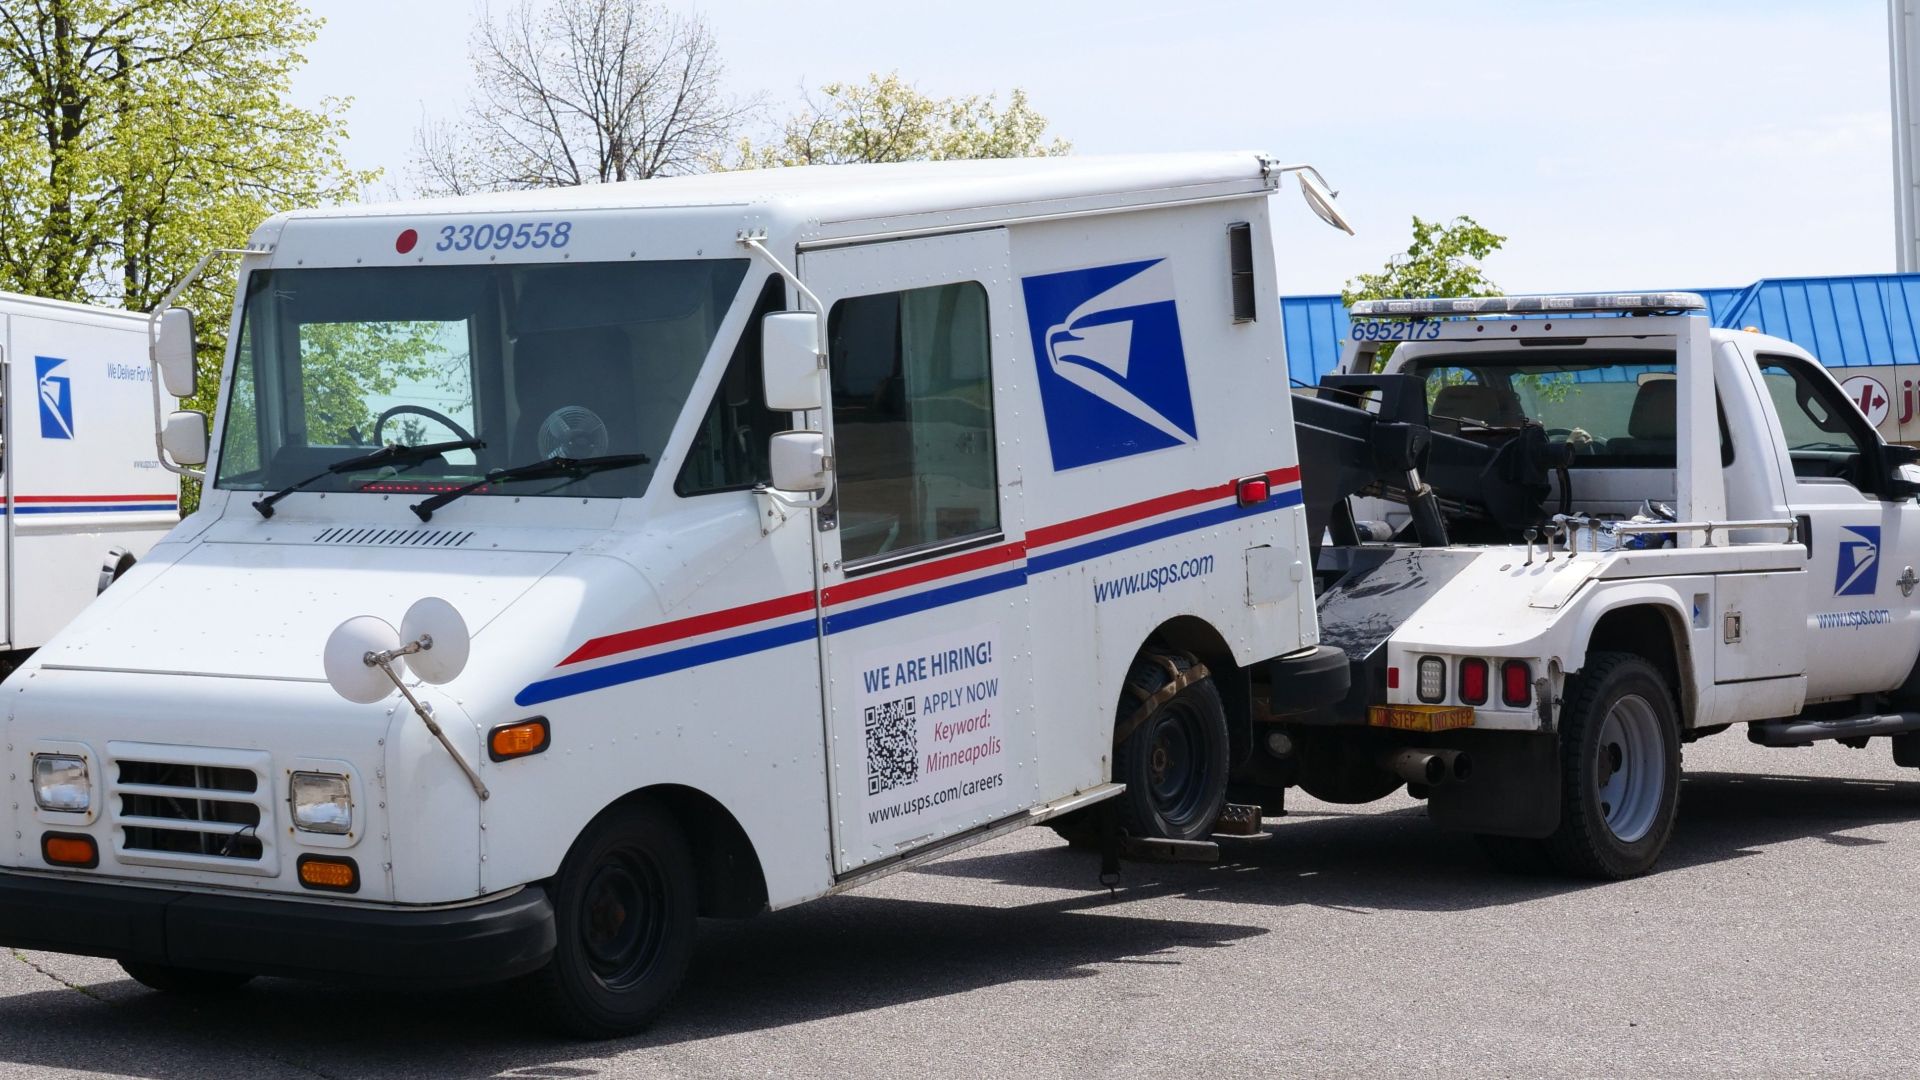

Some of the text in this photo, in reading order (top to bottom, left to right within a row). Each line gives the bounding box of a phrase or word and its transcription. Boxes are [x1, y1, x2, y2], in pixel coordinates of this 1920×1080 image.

[436, 221, 572, 252] 3309558
[1351, 320, 1441, 341] 6952173
[107, 362, 117, 379] We
[117, 363, 136, 381] Deliver
[136, 366, 146, 382] For
[1094, 554, 1214, 603] www.usps.com
[1816, 609, 1891, 631] www.usps.com
[863, 641, 993, 694] WE ARE HIRING!
[923, 677, 999, 716] APPLY NOW
[934, 708, 991, 744] Keyword:
[1391, 711, 1416, 729] STEP
[1434, 709, 1472, 729] NO STEP
[926, 735, 1001, 774] Minneapolis
[868, 772, 1003, 825] www.usps.com/careers
